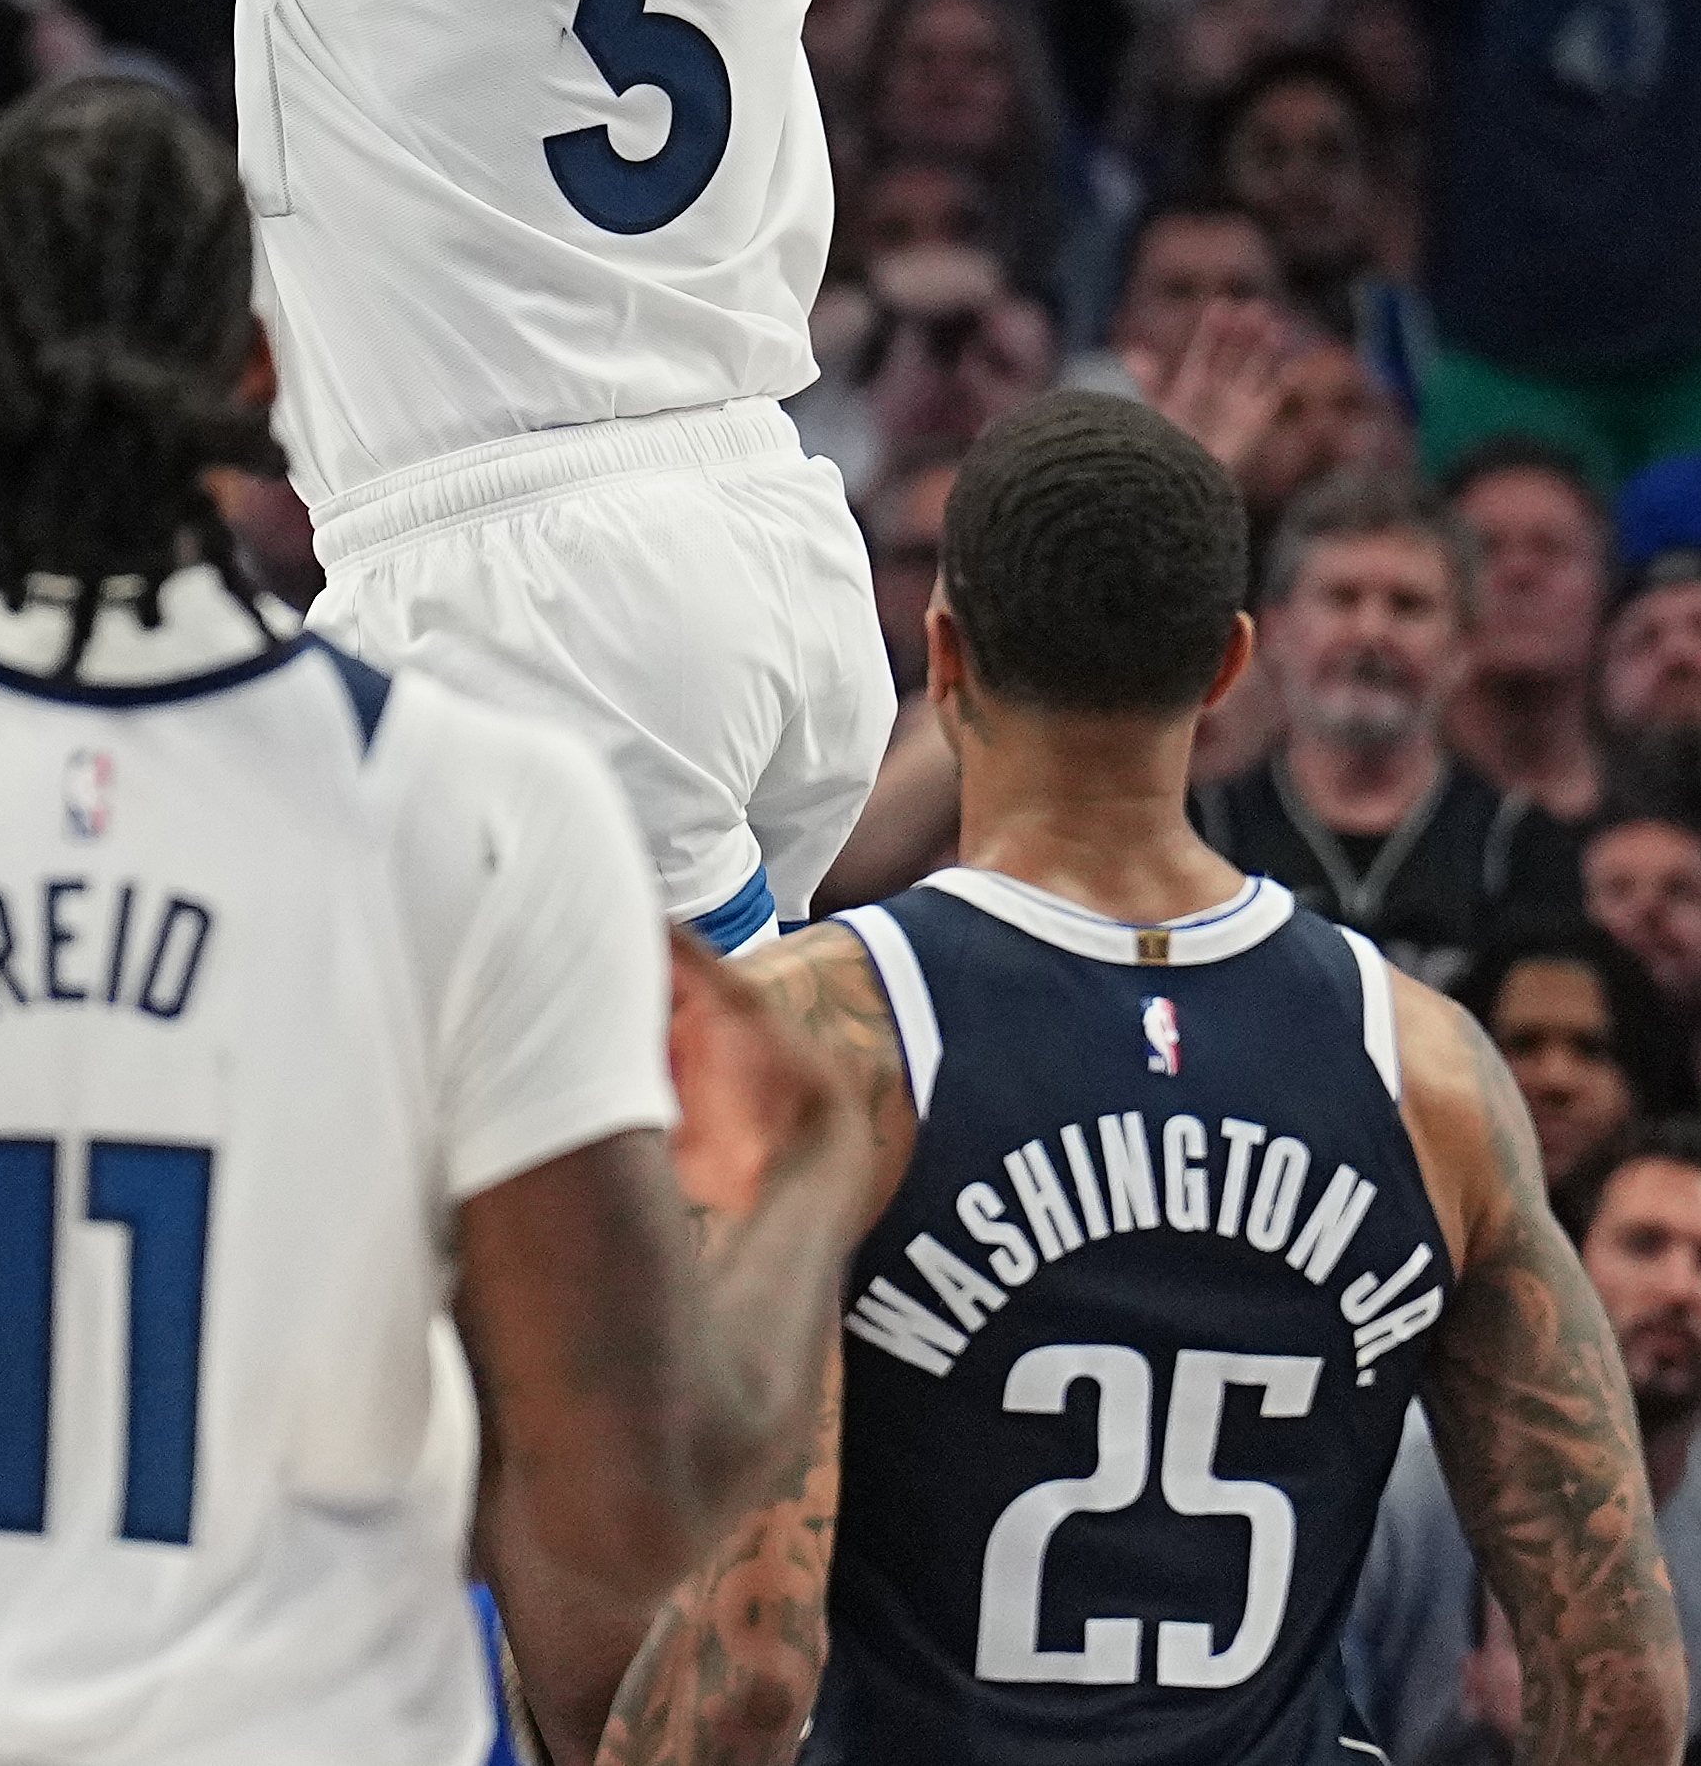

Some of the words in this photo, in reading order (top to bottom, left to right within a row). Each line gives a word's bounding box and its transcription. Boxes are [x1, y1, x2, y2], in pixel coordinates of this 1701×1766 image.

[842, 1110, 1379, 1378] WASHINGTON
[1338, 1241, 1445, 1388] JR.
[974, 1341, 1326, 1690] 25
